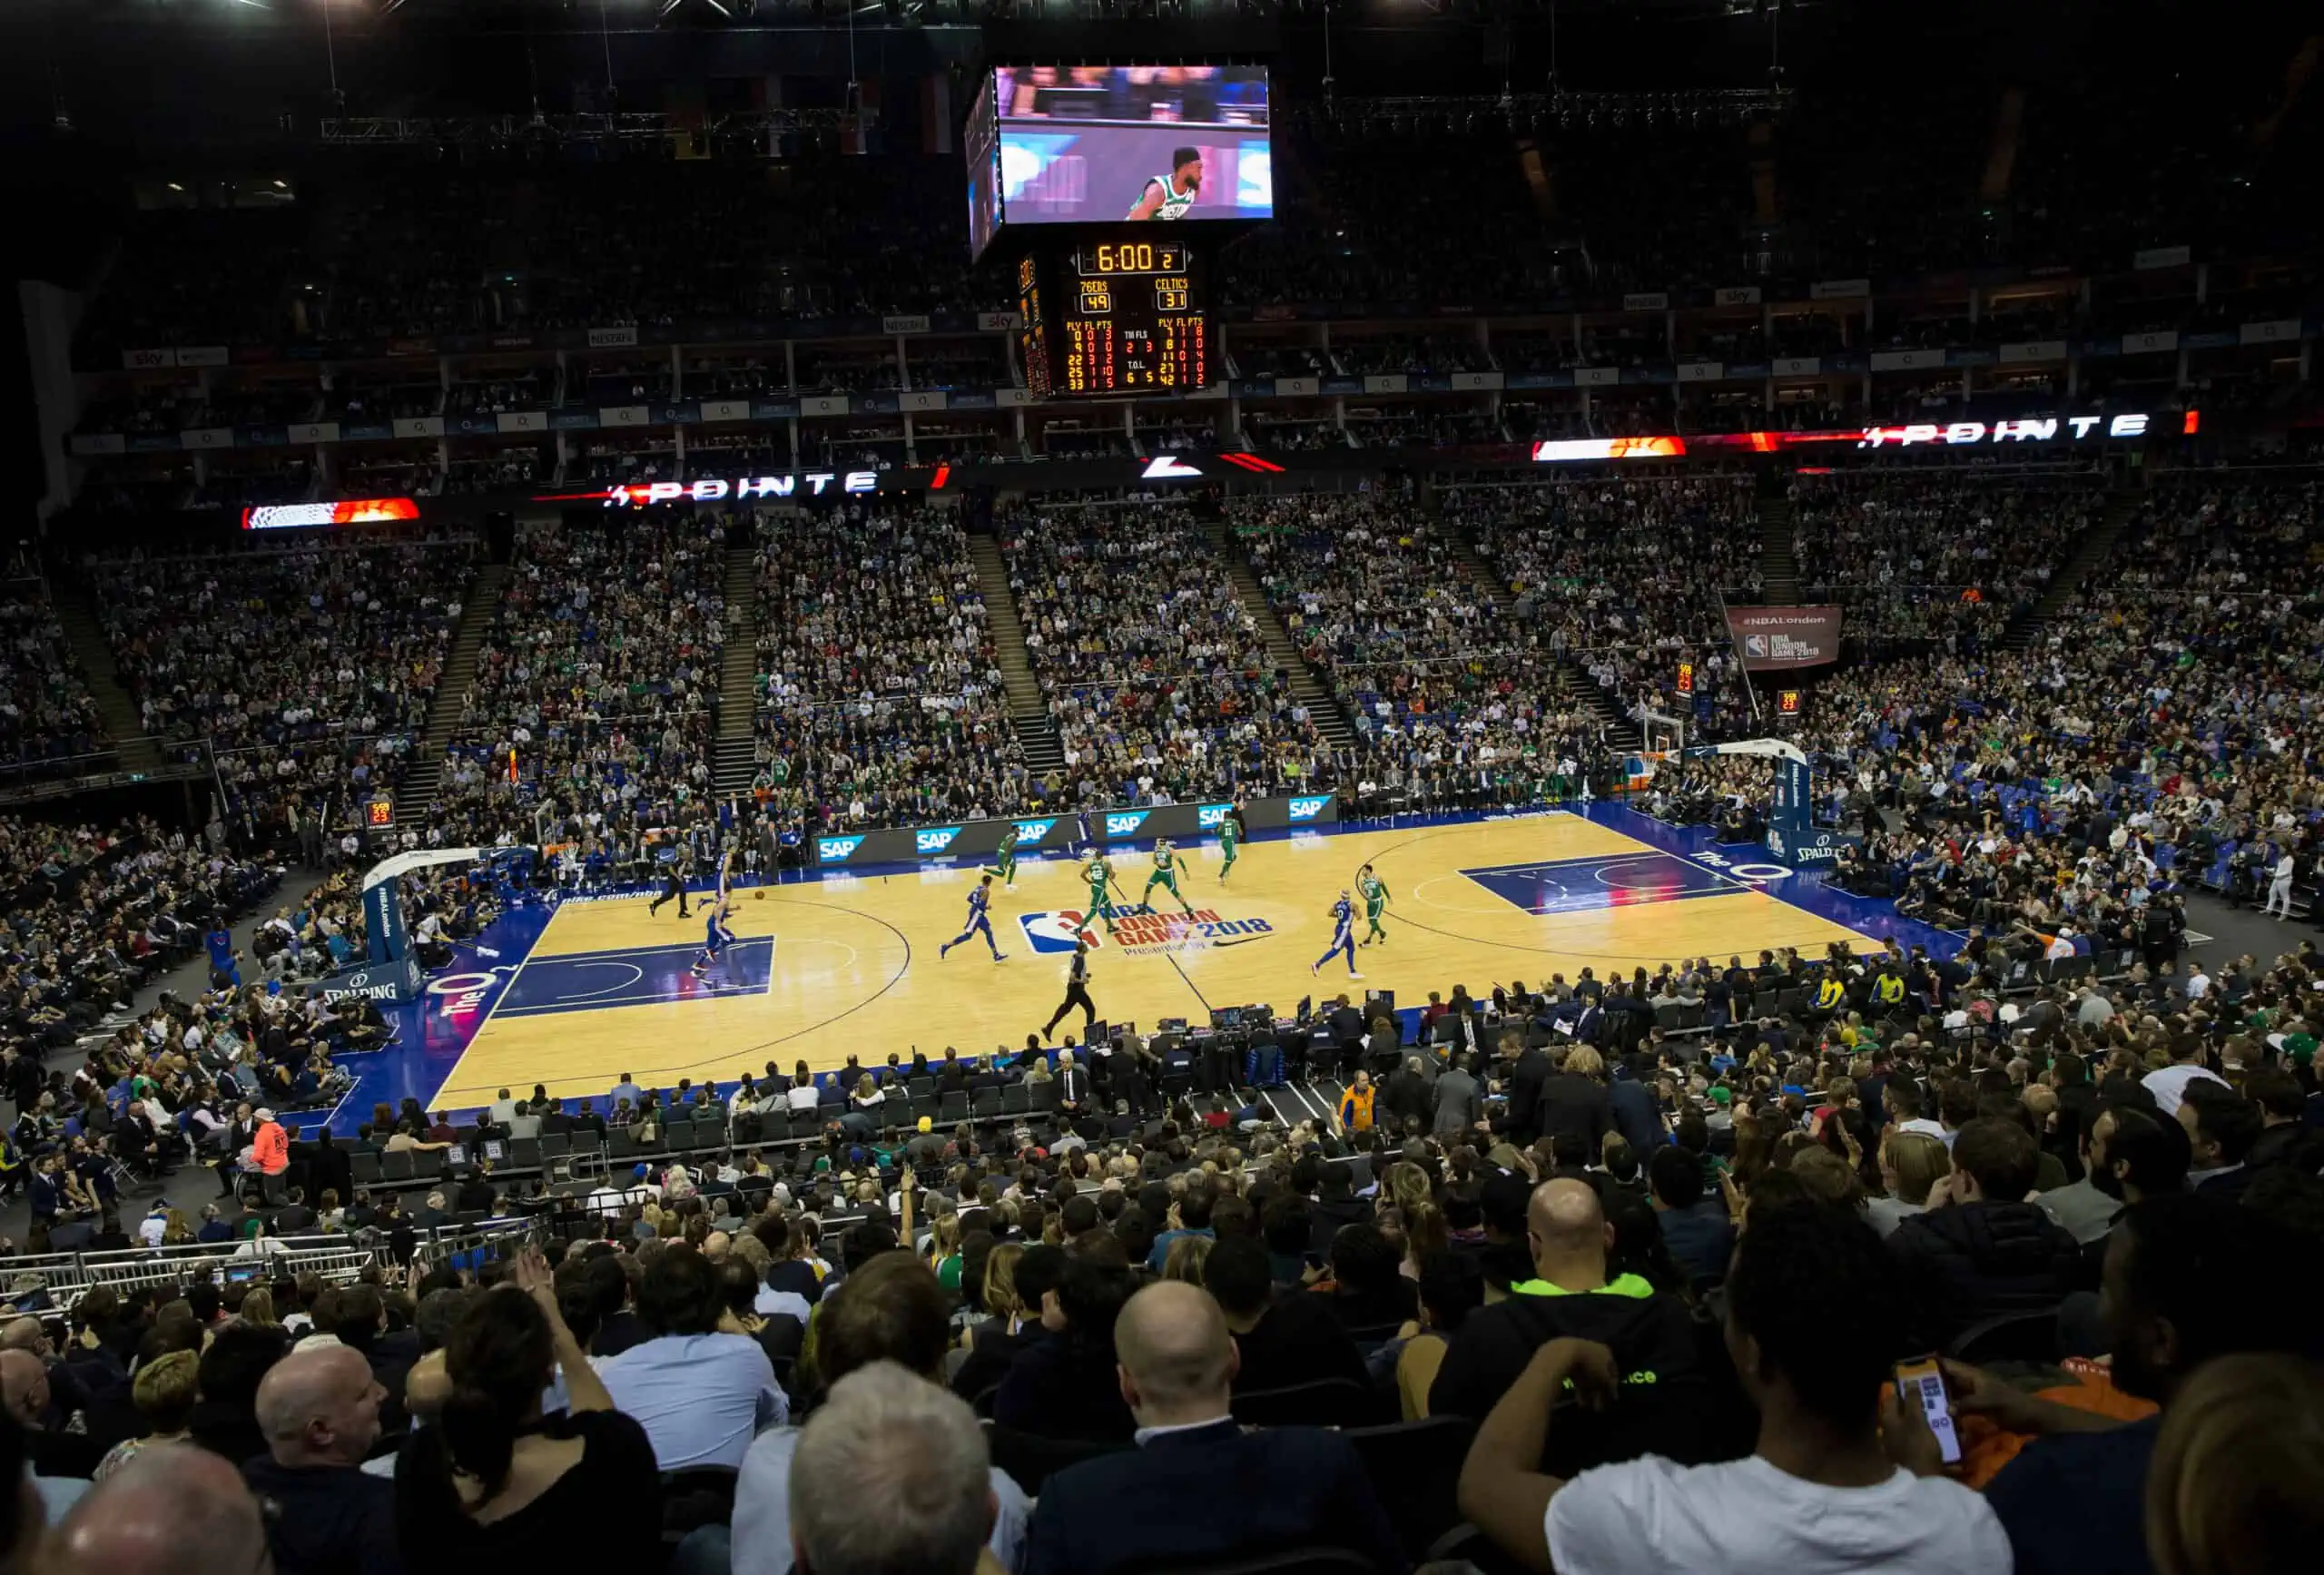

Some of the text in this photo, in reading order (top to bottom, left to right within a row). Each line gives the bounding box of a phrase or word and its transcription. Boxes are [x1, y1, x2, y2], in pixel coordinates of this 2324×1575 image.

[1098, 245, 1151, 271] 6:00
[1163, 253, 1171, 269] 2
[1080, 281, 1108, 293] 76ERS
[1155, 278, 1188, 290] CELTICS
[1088, 296, 1108, 309] 49
[1166, 293, 1185, 307] 31
[988, 315, 1013, 328] sky
[1085, 321, 1094, 330] FL
[1097, 320, 1112, 330] PTS
[1158, 317, 1204, 328] PLY FL PTS
[1074, 330, 1112, 341] 0 0 3
[1075, 341, 1112, 352] 9 0 0
[1126, 341, 1153, 353] 2 3
[1167, 339, 1174, 349] 8
[1196, 338, 1203, 349] 0
[136, 349, 162, 364] sky
[1068, 354, 1113, 366] 22 3 2
[1163, 350, 1203, 360] 11 0 4
[1068, 367, 1082, 378] 25
[1101, 366, 1113, 376] 10
[1160, 363, 1174, 374] 27
[1196, 361, 1203, 371] 0
[1127, 371, 1154, 383] 6 5
[1160, 375, 1174, 385] 42
[1196, 374, 1204, 384] 2
[1068, 379, 1083, 390] 33
[1106, 378, 1113, 388] 5
[1743, 615, 1826, 625] #NBALondon
[1771, 634, 1789, 643] NBA
[1772, 641, 1807, 651] LONDON
[1772, 646, 1819, 657] GAME 2018
[1290, 800, 1323, 818] SAP
[1107, 816, 1140, 835] SAP
[916, 832, 953, 851] SAP
[820, 841, 855, 859] SAP
[1798, 848, 1845, 861] SPALD
[1689, 851, 1732, 867] The
[1118, 909, 1222, 931] ONDON
[1114, 918, 1273, 946] GAM 2018
[440, 989, 486, 1017] The
